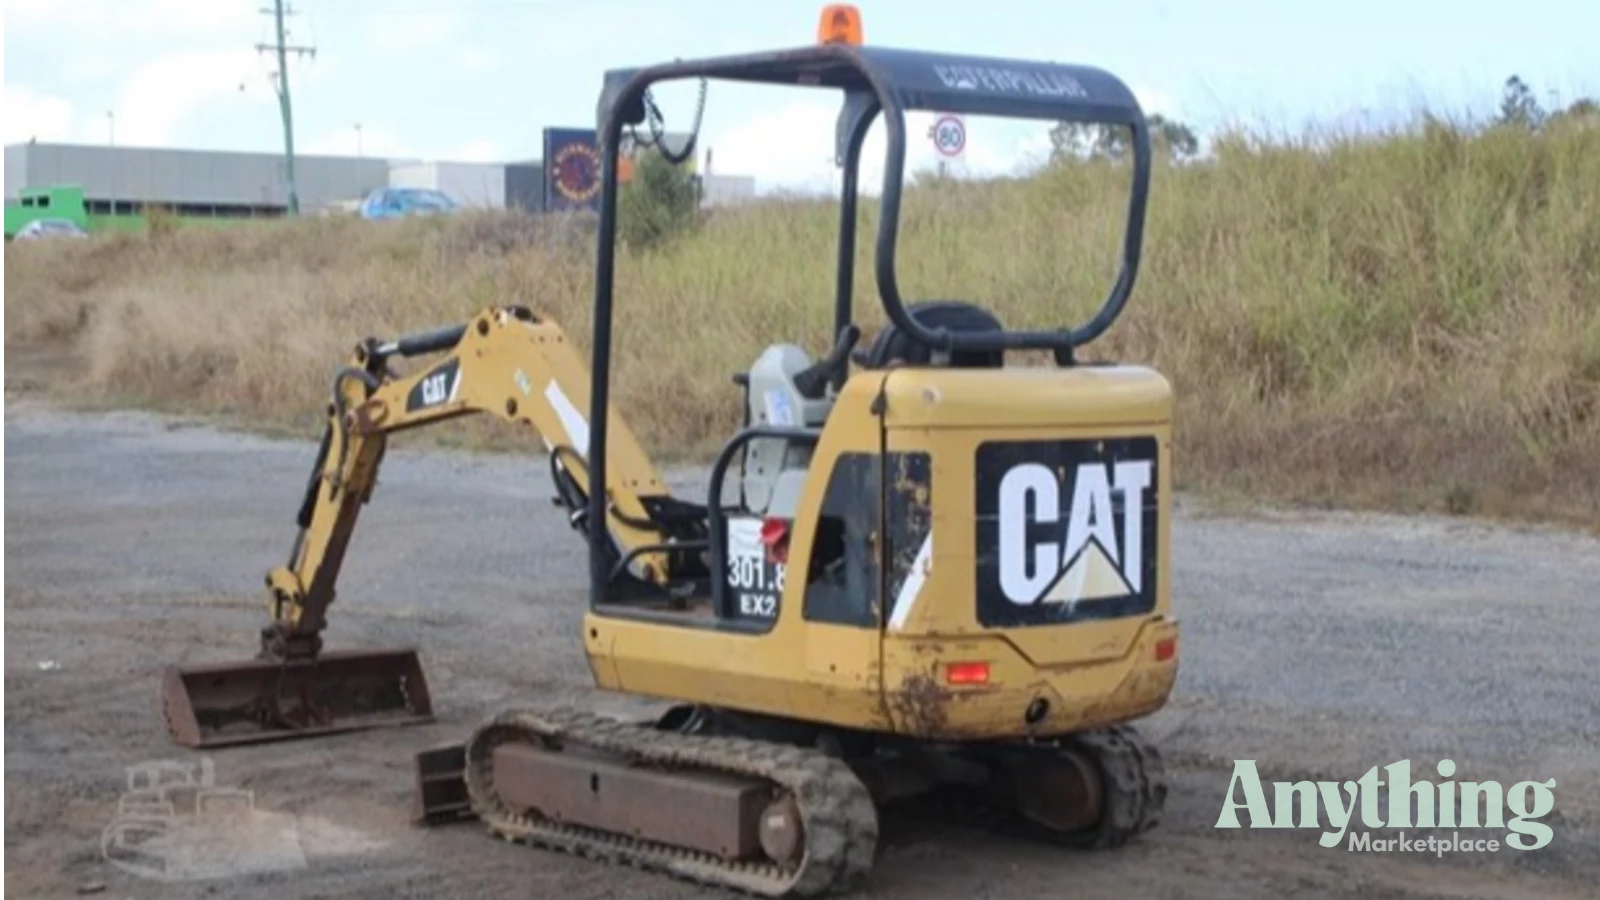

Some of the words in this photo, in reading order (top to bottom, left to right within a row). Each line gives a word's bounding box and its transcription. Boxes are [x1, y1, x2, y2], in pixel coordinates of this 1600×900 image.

[933, 65, 1087, 97] CATERPILLAR
[939, 126, 961, 147] 80
[422, 373, 447, 405] CAT
[999, 459, 1153, 606] CAT
